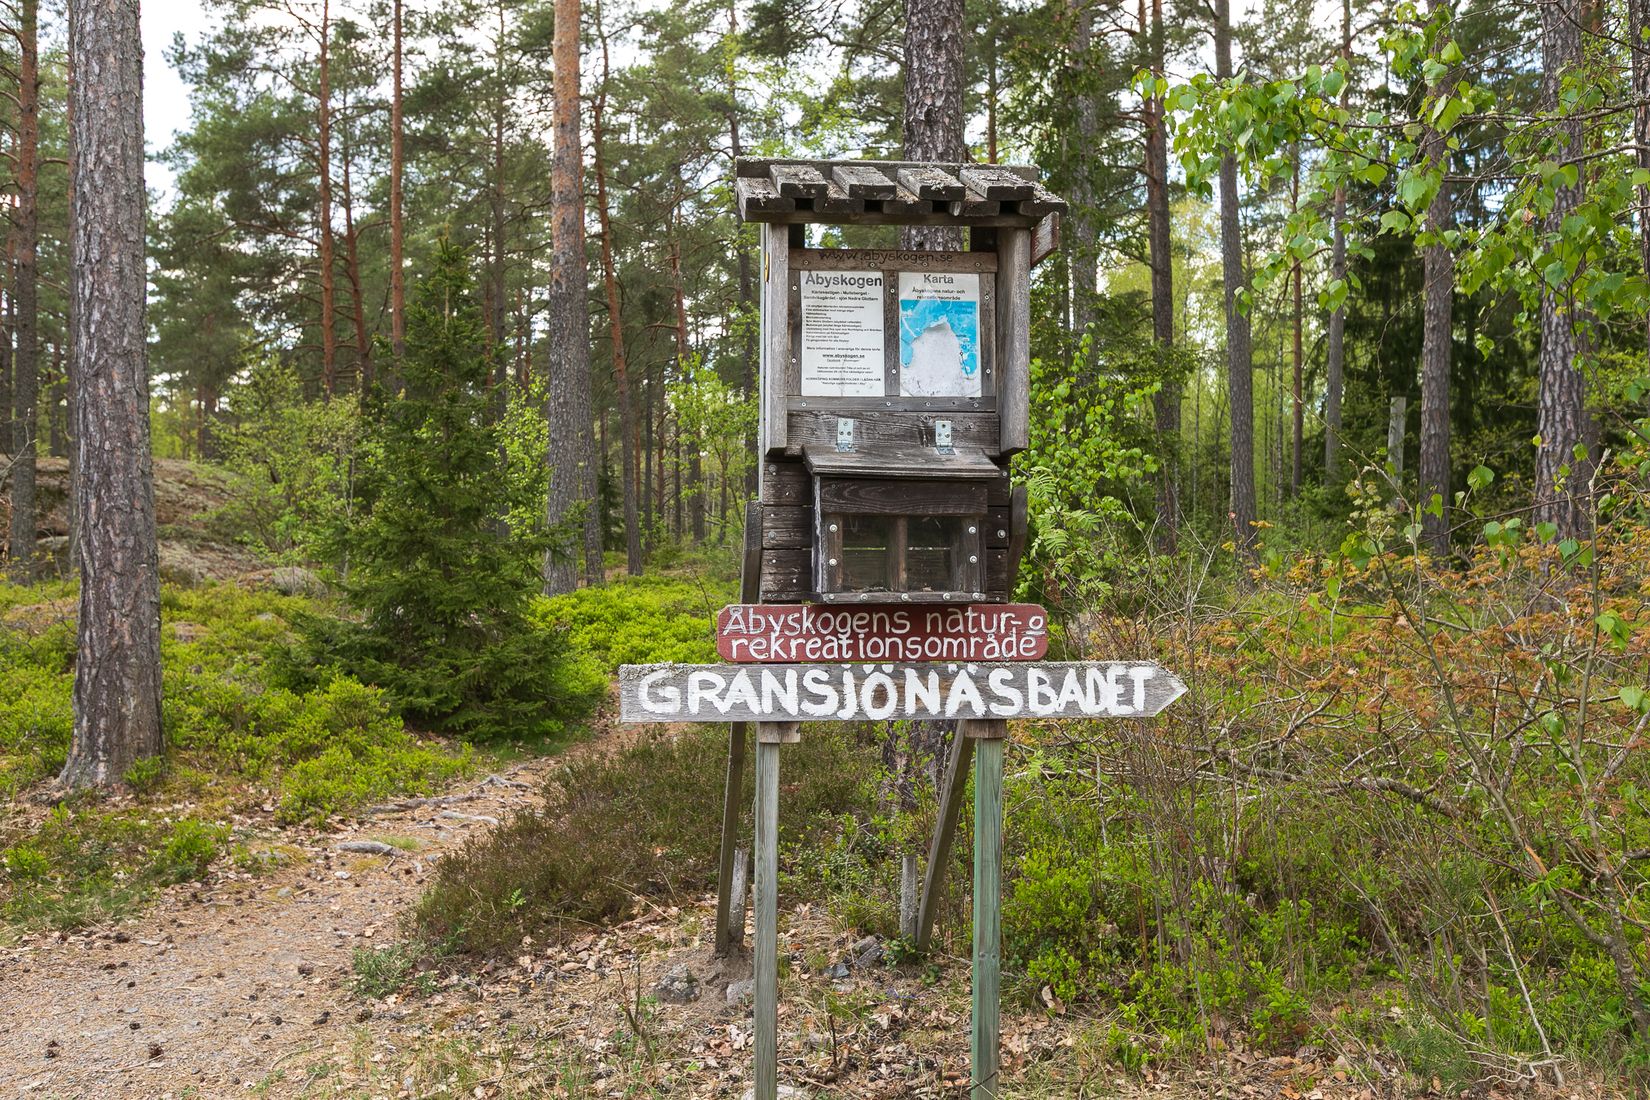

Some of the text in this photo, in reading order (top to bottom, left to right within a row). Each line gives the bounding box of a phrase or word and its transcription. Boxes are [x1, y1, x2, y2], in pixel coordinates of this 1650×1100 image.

[923, 274, 954, 284] Karta
[722, 605, 910, 638] Åbyskogens
[730, 628, 1038, 660] rekreationsområde
[638, 663, 1155, 721] GRANSJÖNÄSBADET
